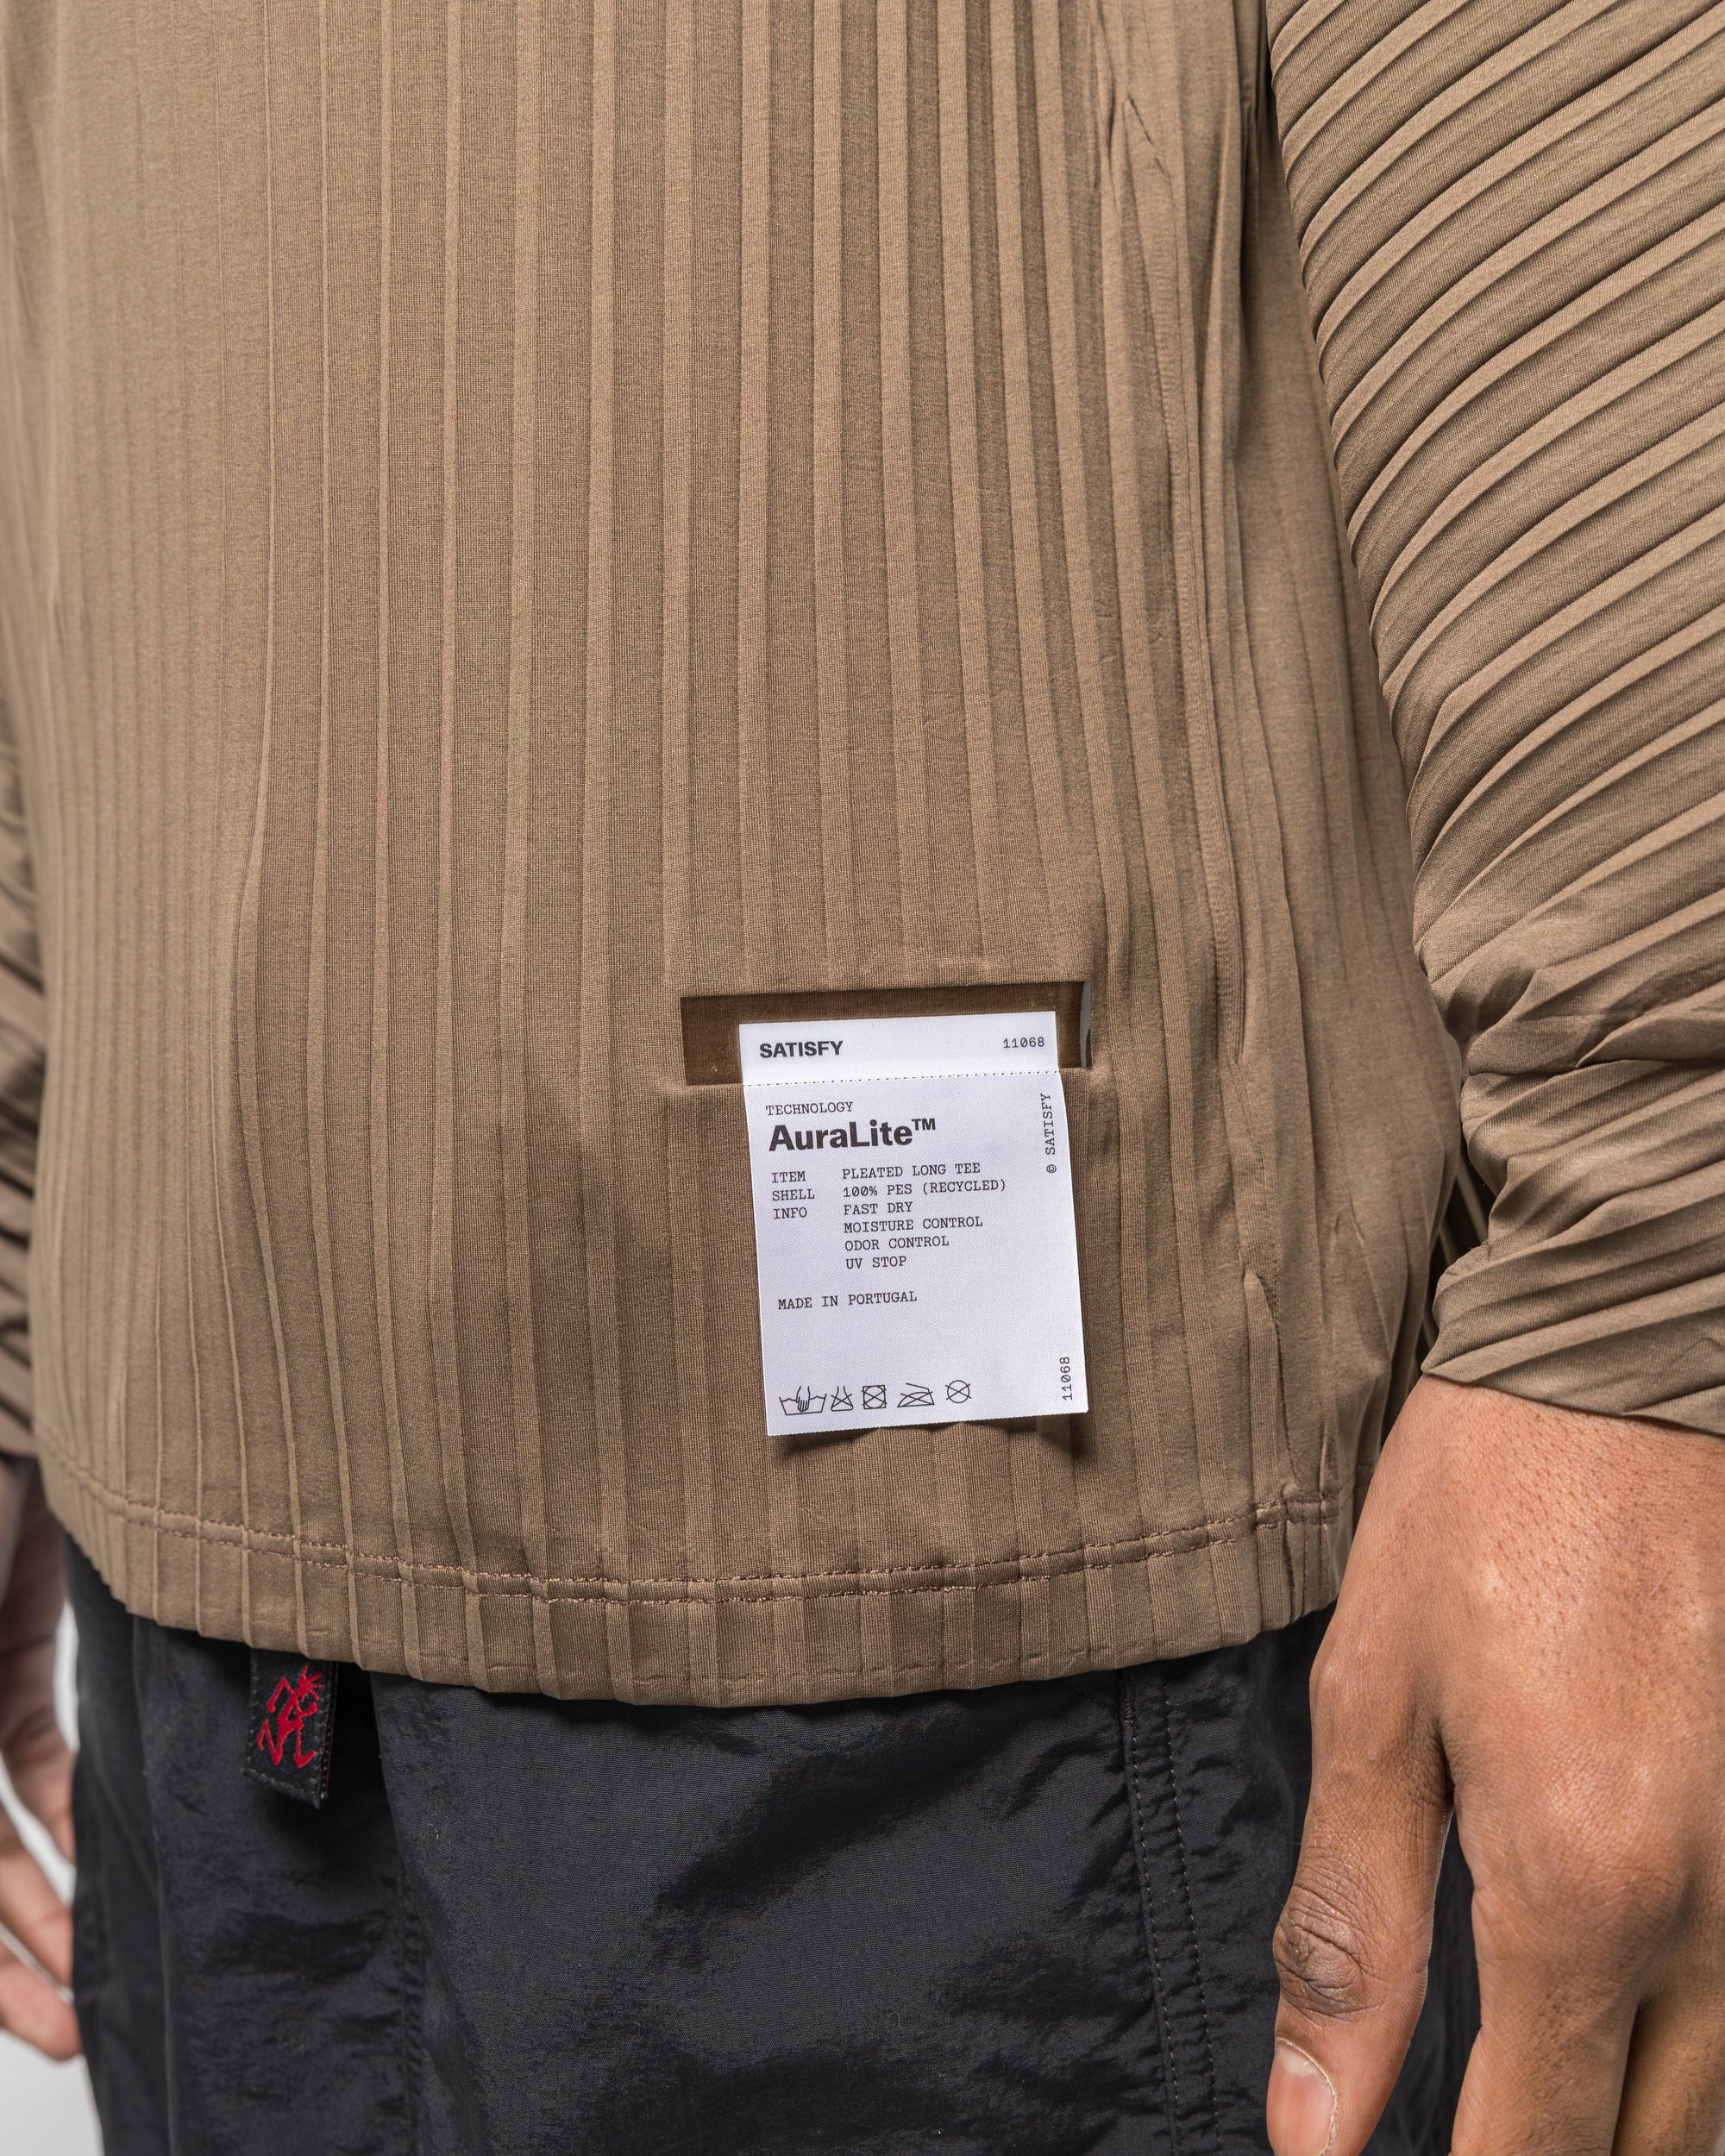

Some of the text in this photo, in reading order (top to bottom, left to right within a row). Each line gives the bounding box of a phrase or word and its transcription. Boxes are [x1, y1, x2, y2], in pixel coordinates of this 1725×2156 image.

[760, 1041, 843, 1058] SATISFY
[1003, 1037, 1044, 1048] 11068
[766, 1101, 853, 1115] TECHNOLOGY
[1040, 1094, 1055, 1155] SATISFY
[771, 1163, 980, 1183] ITEM PLEATED LONG TEE
[773, 1179, 1005, 1201] SHELL 100% PES (RECYCLED)
[774, 1201, 913, 1219] INFO FAST DRY
[844, 1216, 982, 1233] MOISTURE CONTROL
[845, 1236, 949, 1251] ODOR CONTROL
[845, 1256, 906, 1269] UV STOP
[778, 1291, 917, 1310] MADE IN PORTUGAL
[1060, 1357, 1072, 1400] 11068
